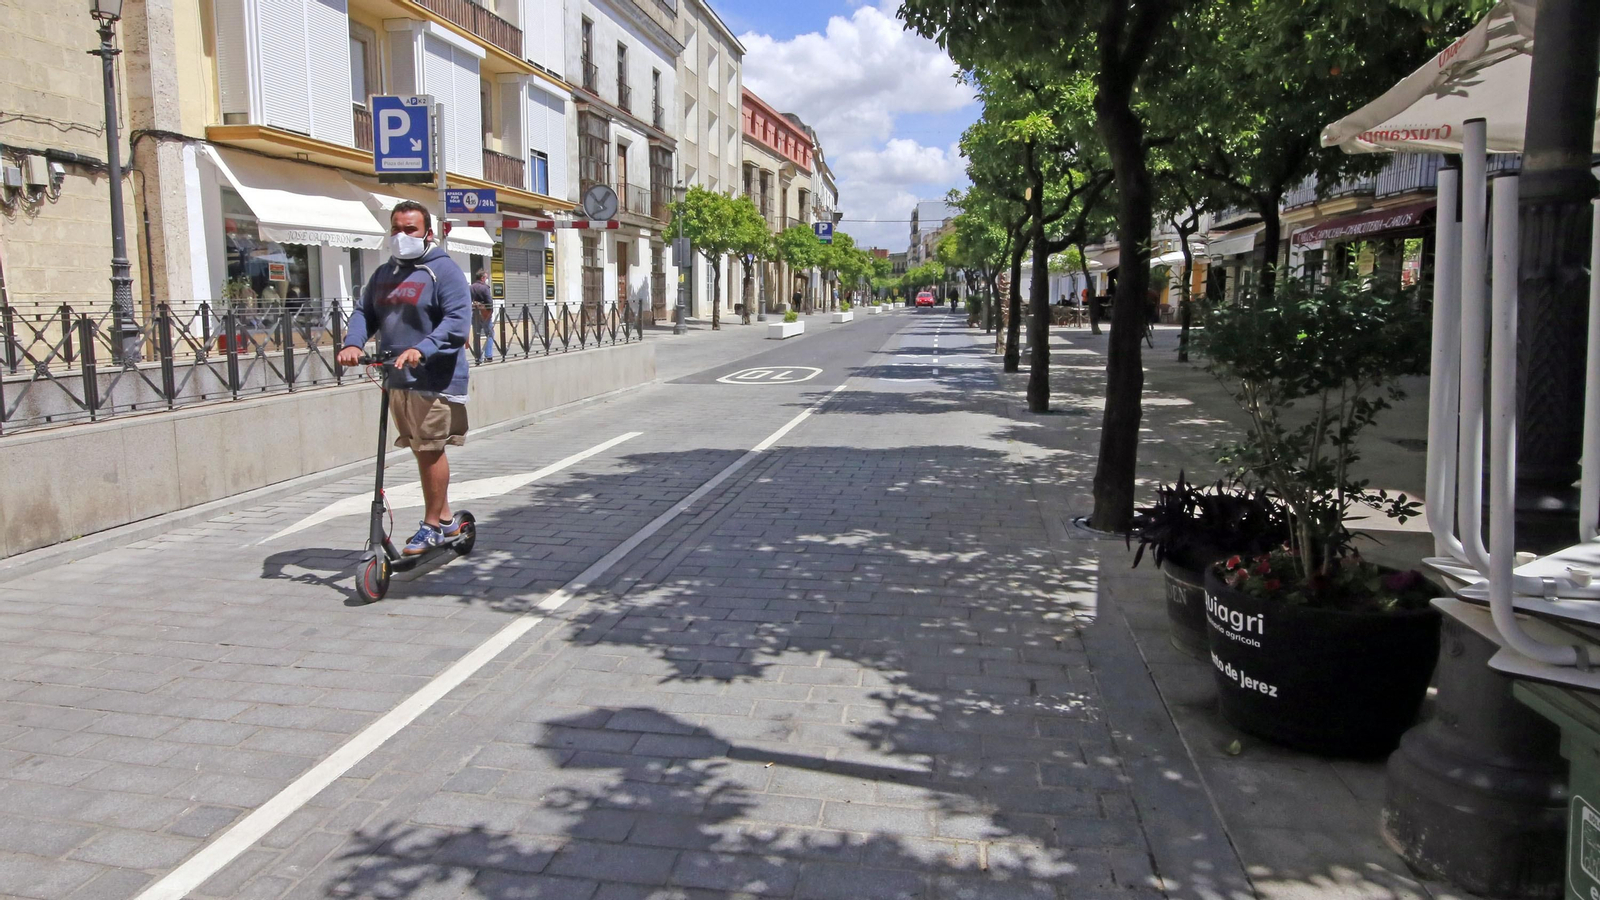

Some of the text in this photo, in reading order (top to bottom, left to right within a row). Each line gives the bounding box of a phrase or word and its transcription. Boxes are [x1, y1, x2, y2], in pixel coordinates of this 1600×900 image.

[379, 108, 411, 155] P
[818, 223, 828, 234] P
[1224, 662, 1238, 681] de
[1240, 670, 1278, 698] Jerez
